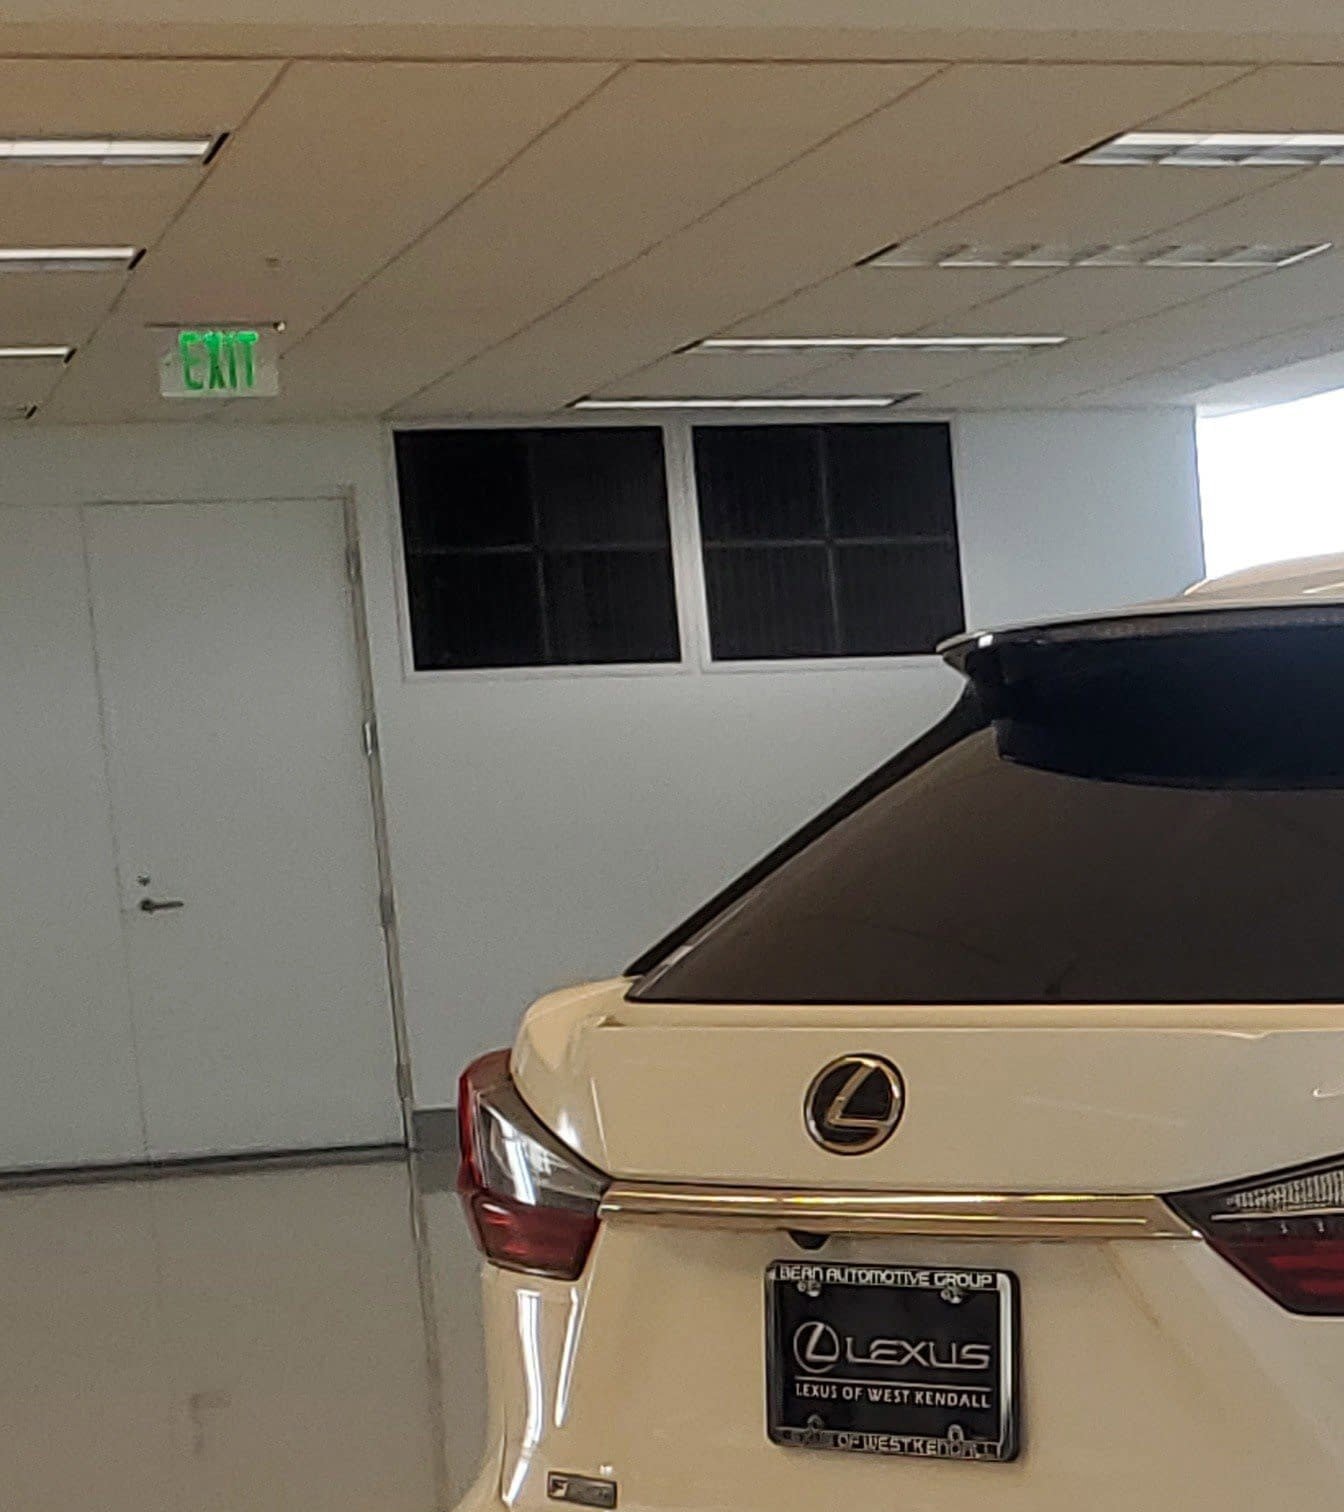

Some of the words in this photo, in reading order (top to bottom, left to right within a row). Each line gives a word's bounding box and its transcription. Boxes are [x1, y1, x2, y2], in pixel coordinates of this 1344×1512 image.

[179, 332, 258, 389] EXIT
[826, 1268, 930, 1285] AUTOMOTIVE
[934, 1273, 992, 1287] GROUP
[846, 1338, 991, 1369] LEXUS
[796, 1383, 837, 1398] LEXUS
[842, 1386, 863, 1400] OF
[867, 1388, 909, 1404] WEST
[915, 1391, 991, 1408] KENDALL
[863, 1434, 907, 1451] WEST
